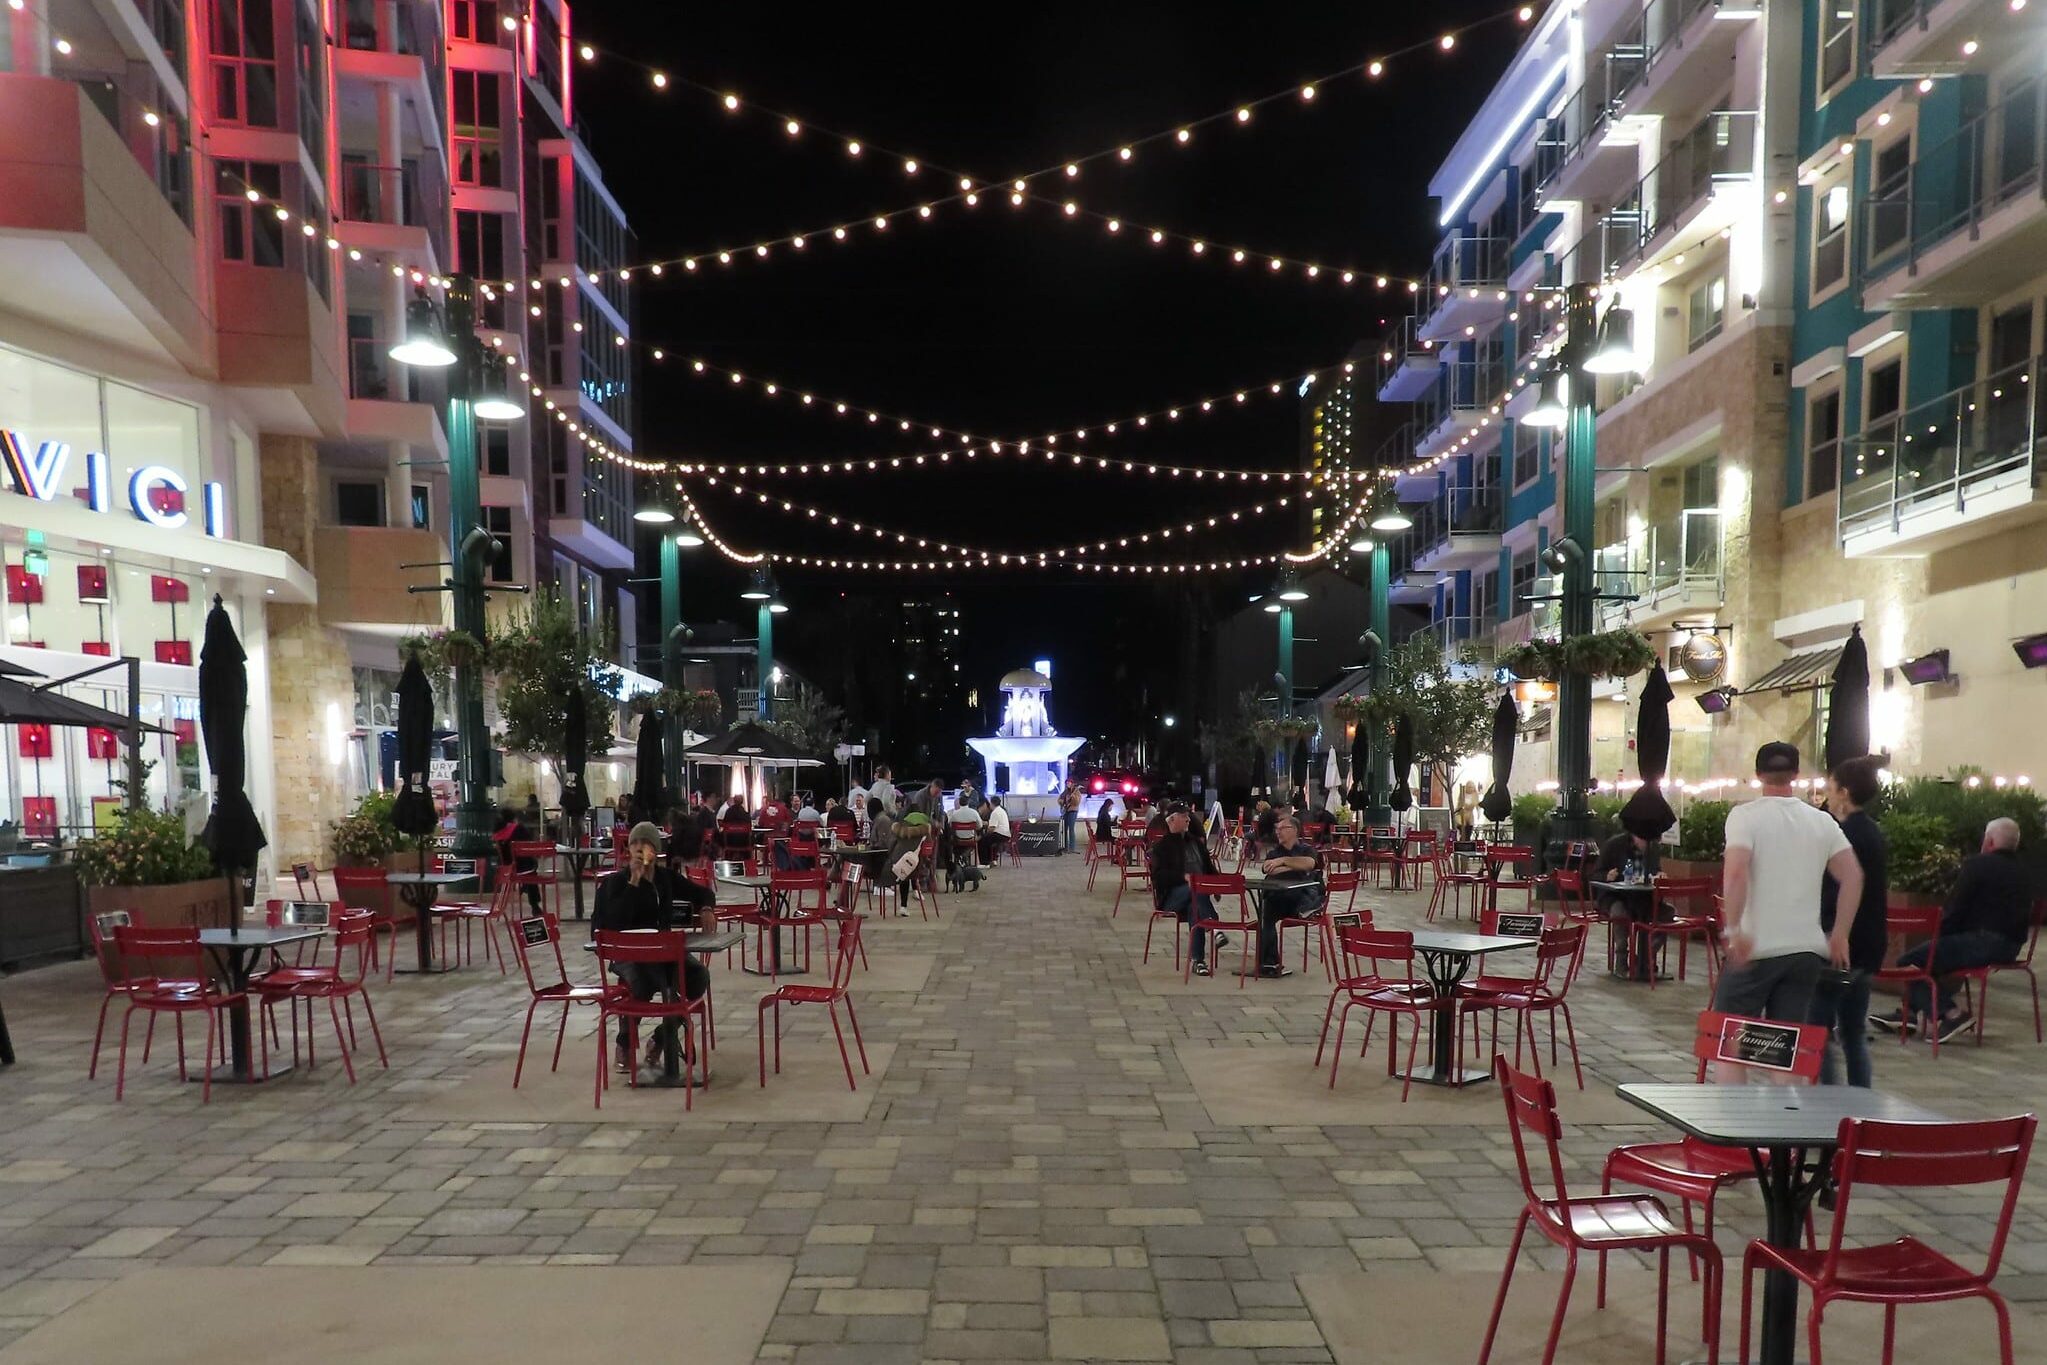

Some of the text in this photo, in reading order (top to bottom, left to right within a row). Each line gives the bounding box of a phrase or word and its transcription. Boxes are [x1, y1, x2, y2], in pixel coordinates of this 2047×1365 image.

[0, 429, 224, 539] VICI
[432, 762, 453, 771] URY
[1730, 1027, 1788, 1057] Famiglia
